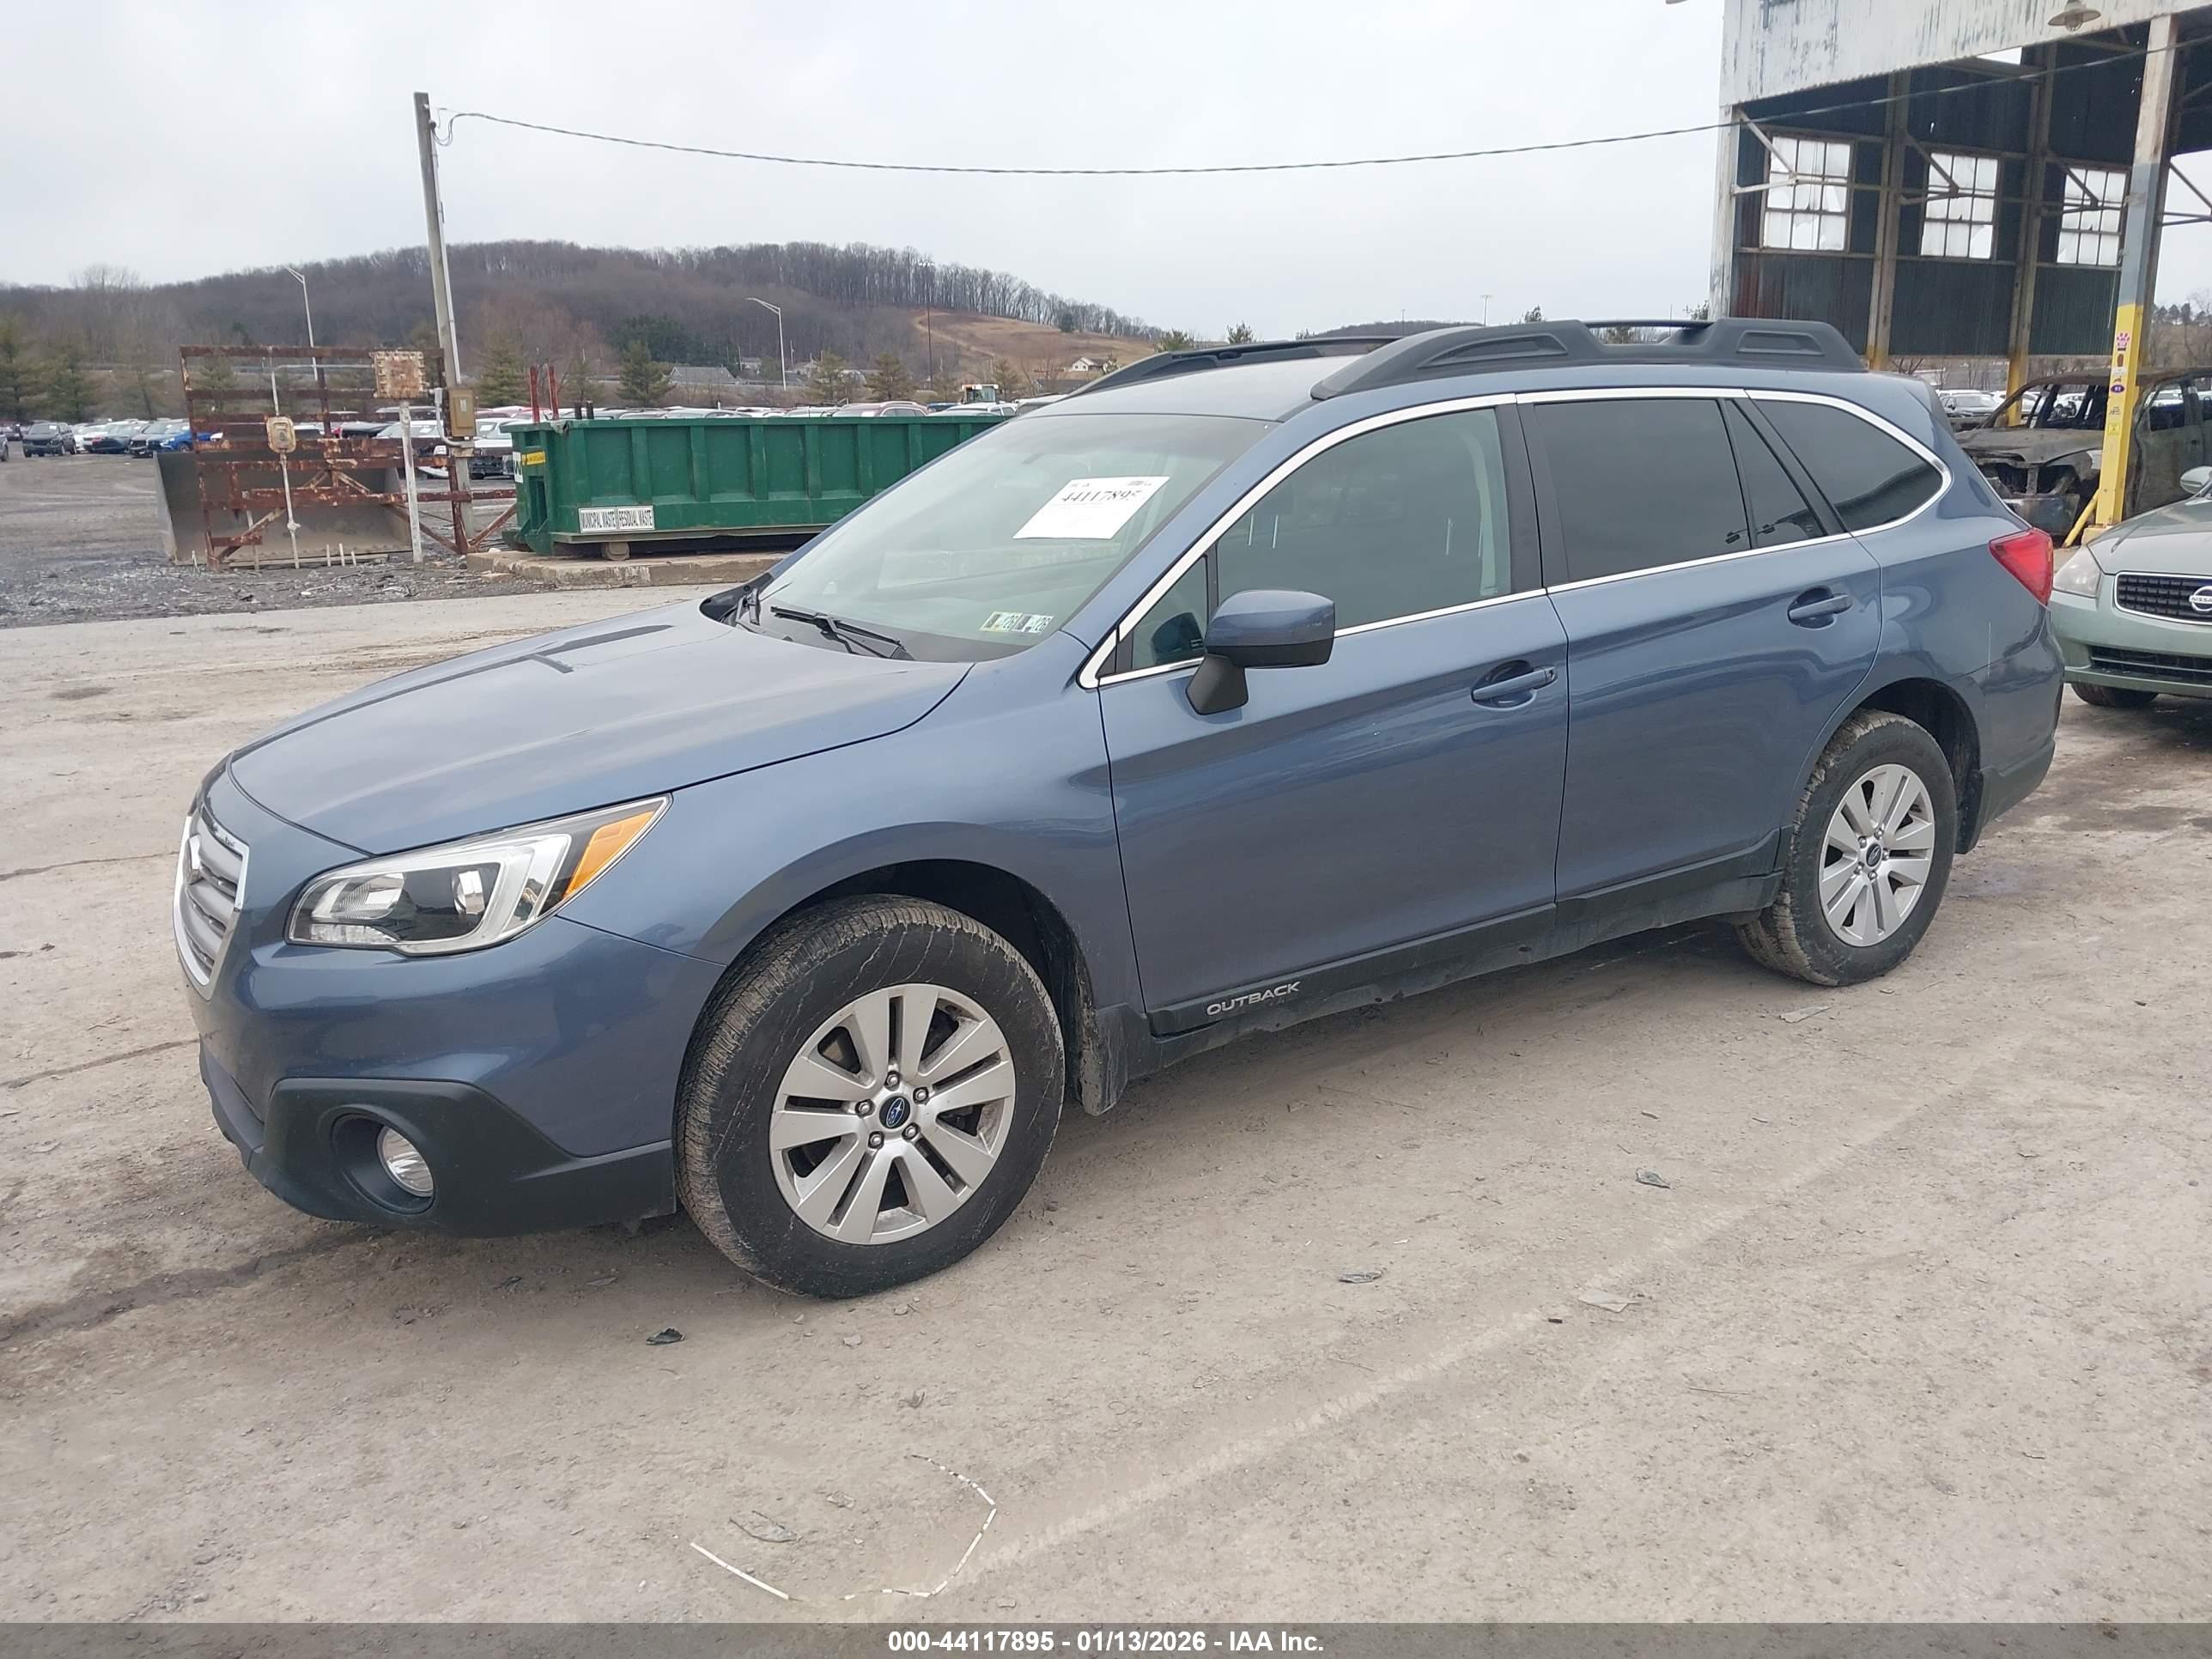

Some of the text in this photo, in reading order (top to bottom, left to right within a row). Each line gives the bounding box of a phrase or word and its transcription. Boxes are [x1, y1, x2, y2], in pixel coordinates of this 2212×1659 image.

[581, 511, 617, 529] MUNICIPAL WASTE
[619, 509, 653, 527] RESIDUAL WASTE
[1206, 981, 1301, 1016] OUTBACK
